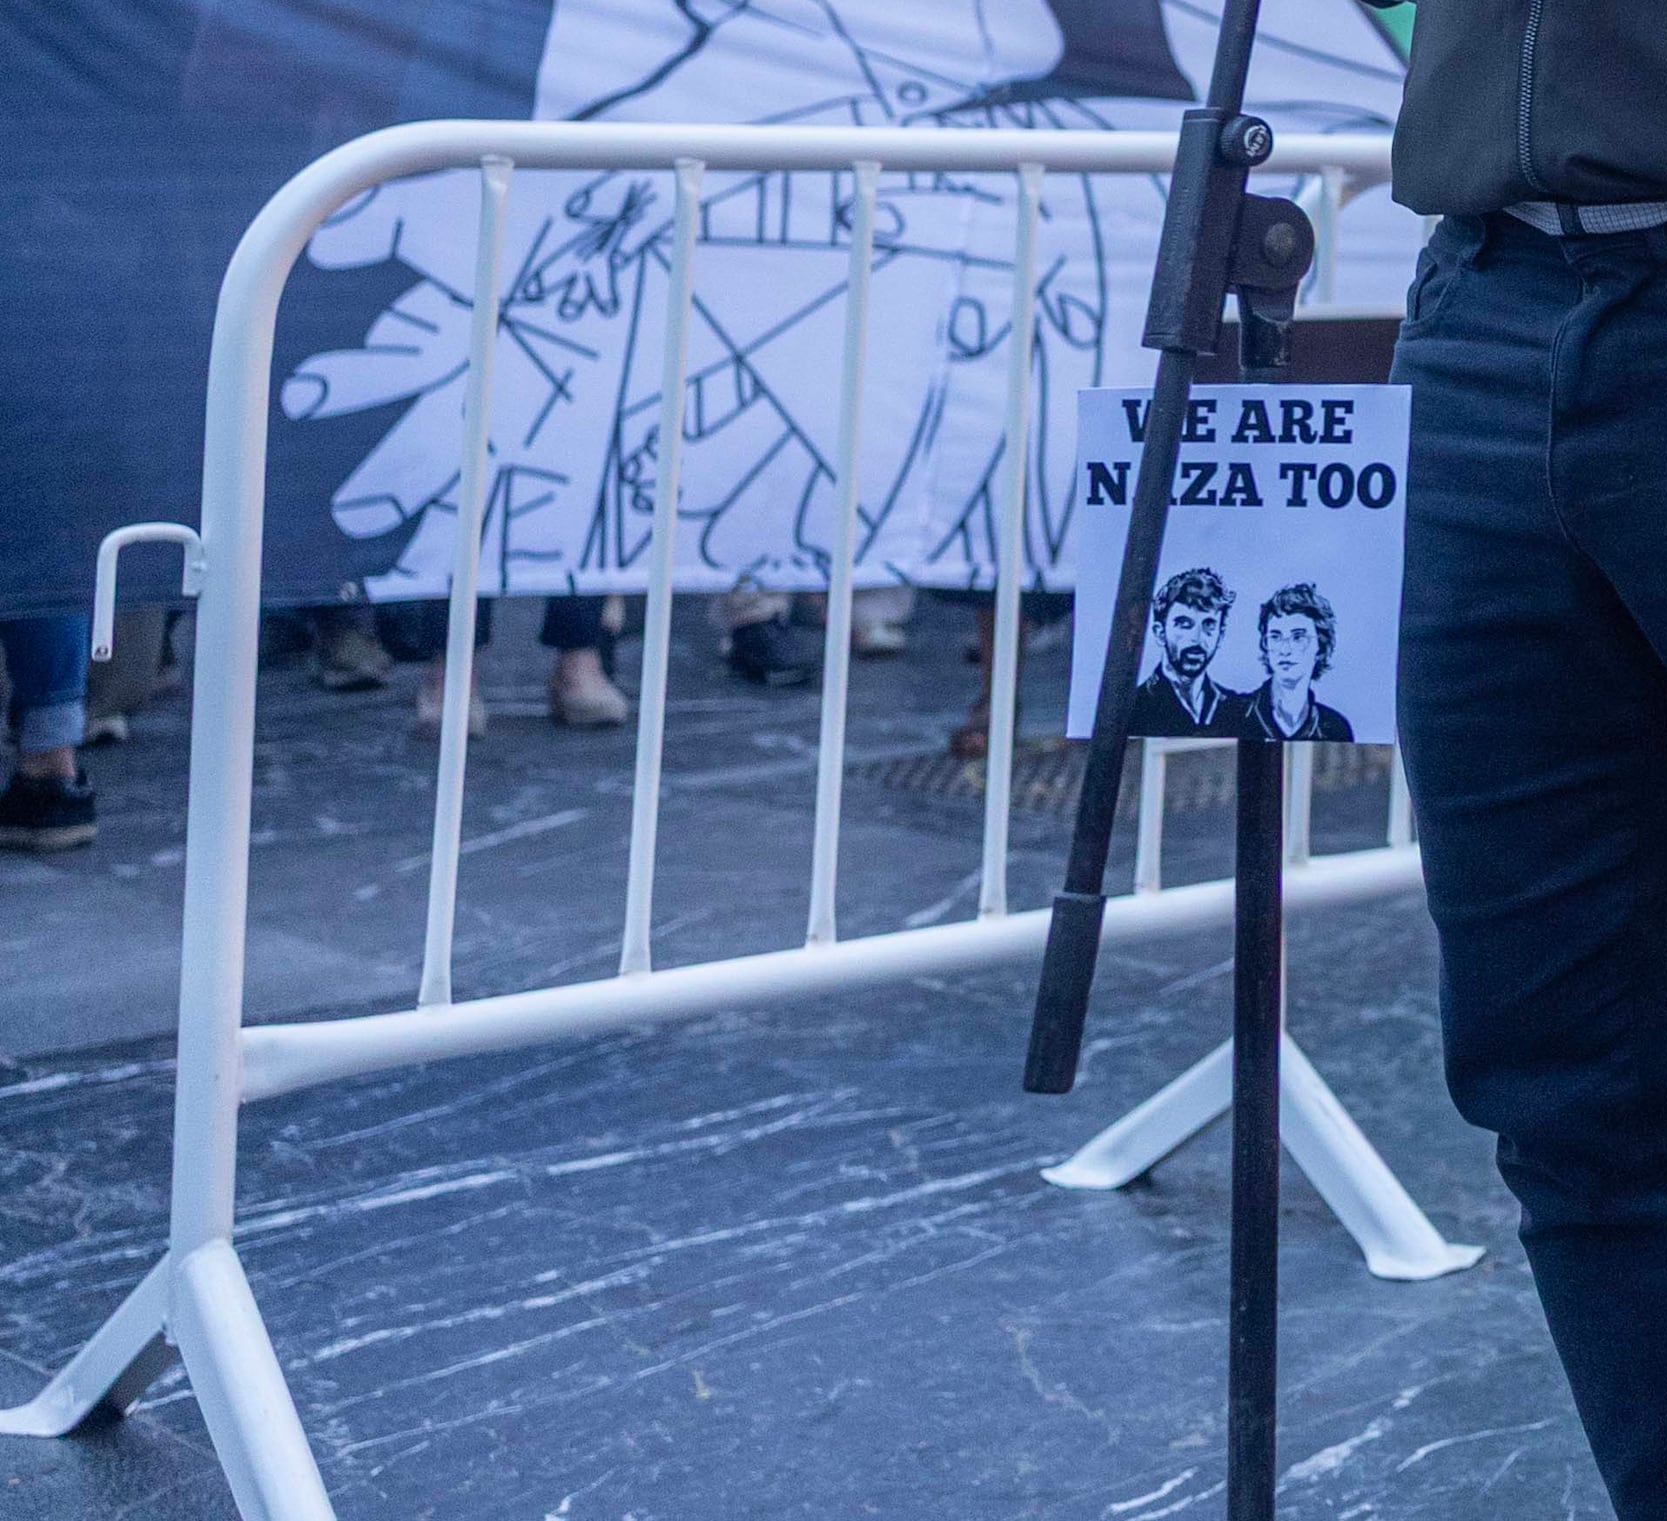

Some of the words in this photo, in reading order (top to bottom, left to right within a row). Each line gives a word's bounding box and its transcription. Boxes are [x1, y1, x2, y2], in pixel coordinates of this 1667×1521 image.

[1231, 399, 1354, 444] ARE
[1086, 461, 1263, 507] NZA
[1279, 462, 1397, 509] TOO
